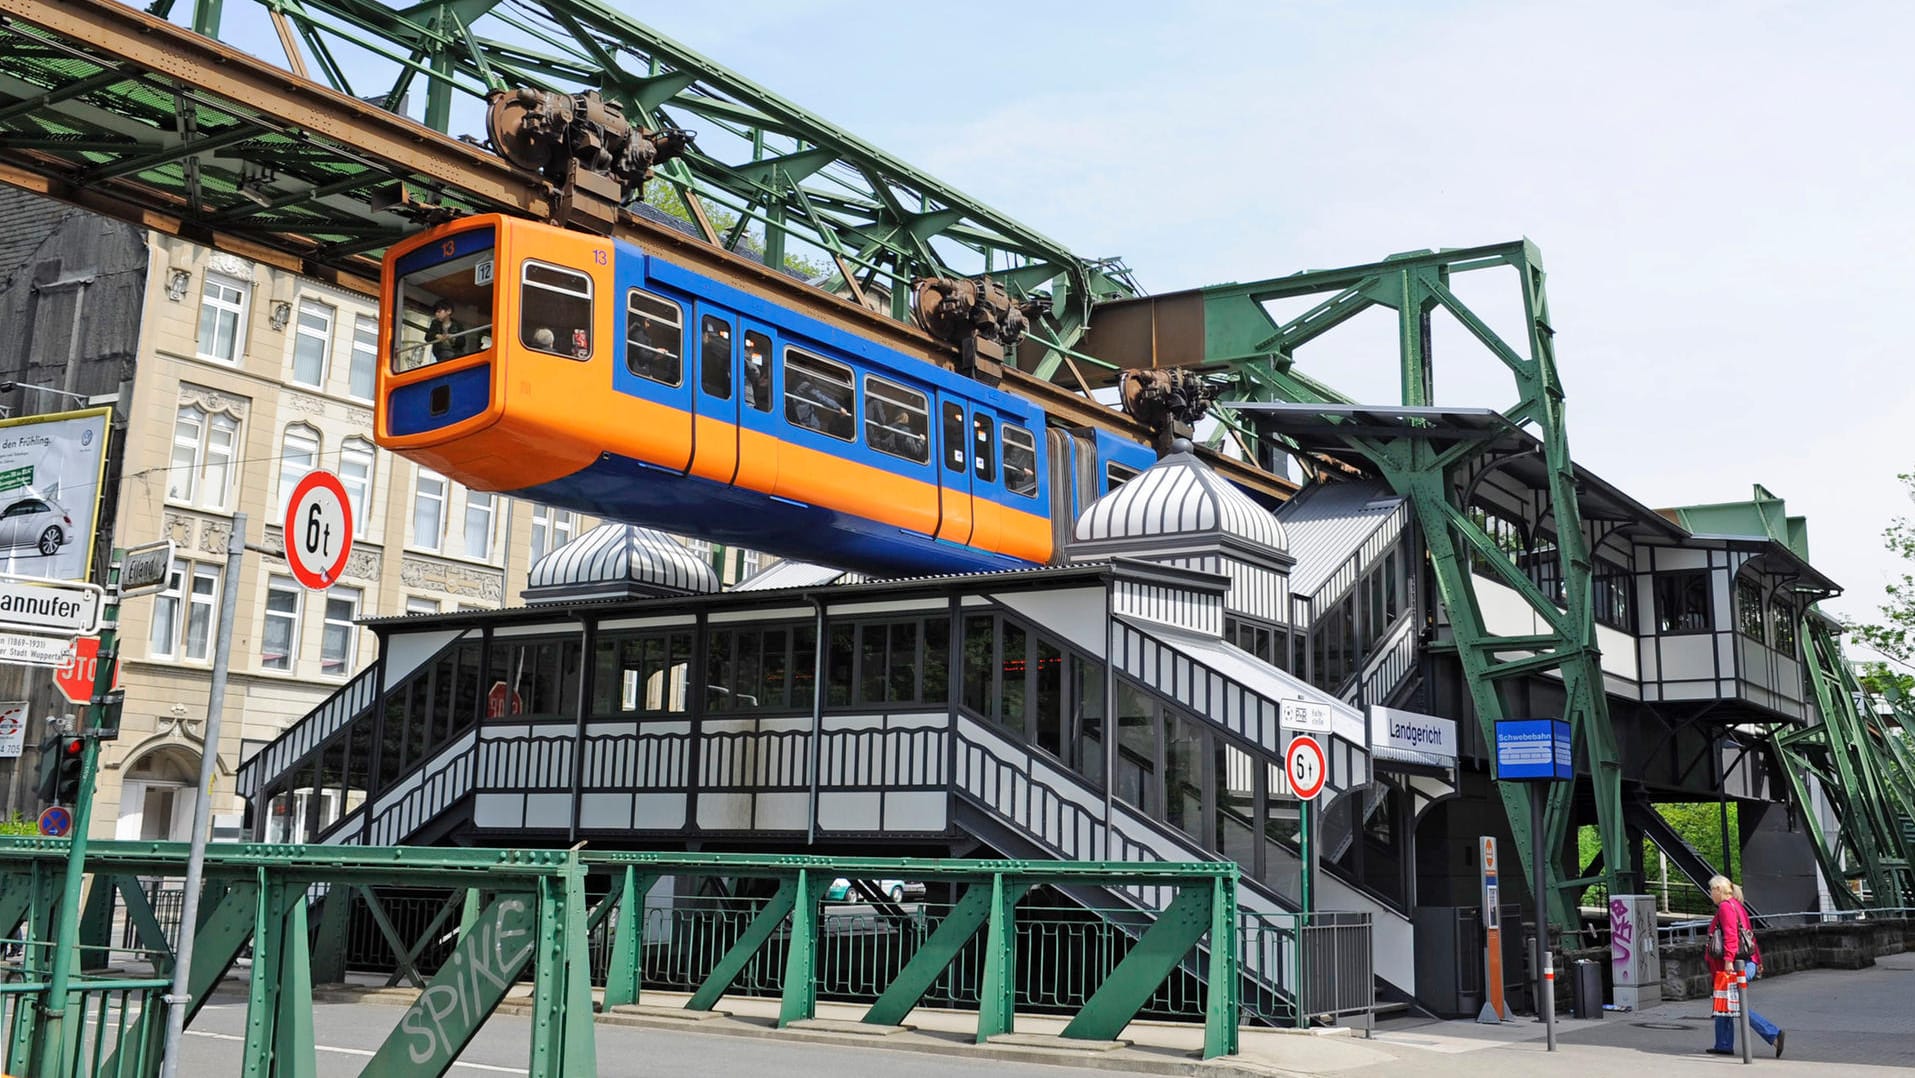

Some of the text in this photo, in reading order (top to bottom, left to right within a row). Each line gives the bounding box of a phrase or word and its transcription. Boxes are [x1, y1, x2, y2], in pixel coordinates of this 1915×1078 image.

[441, 240, 456, 258] 13
[592, 249, 608, 266] 13
[478, 262, 491, 280] 12
[2, 439, 17, 450] den
[128, 557, 156, 580] Eiland
[0, 594, 81, 618] annufer
[10, 648, 28, 658] Stadt
[31, 650, 63, 661] Wuppertal
[61, 656, 98, 682] STO
[1389, 718, 1443, 747] Landgericht
[1498, 732, 1552, 741] Schwebebahn
